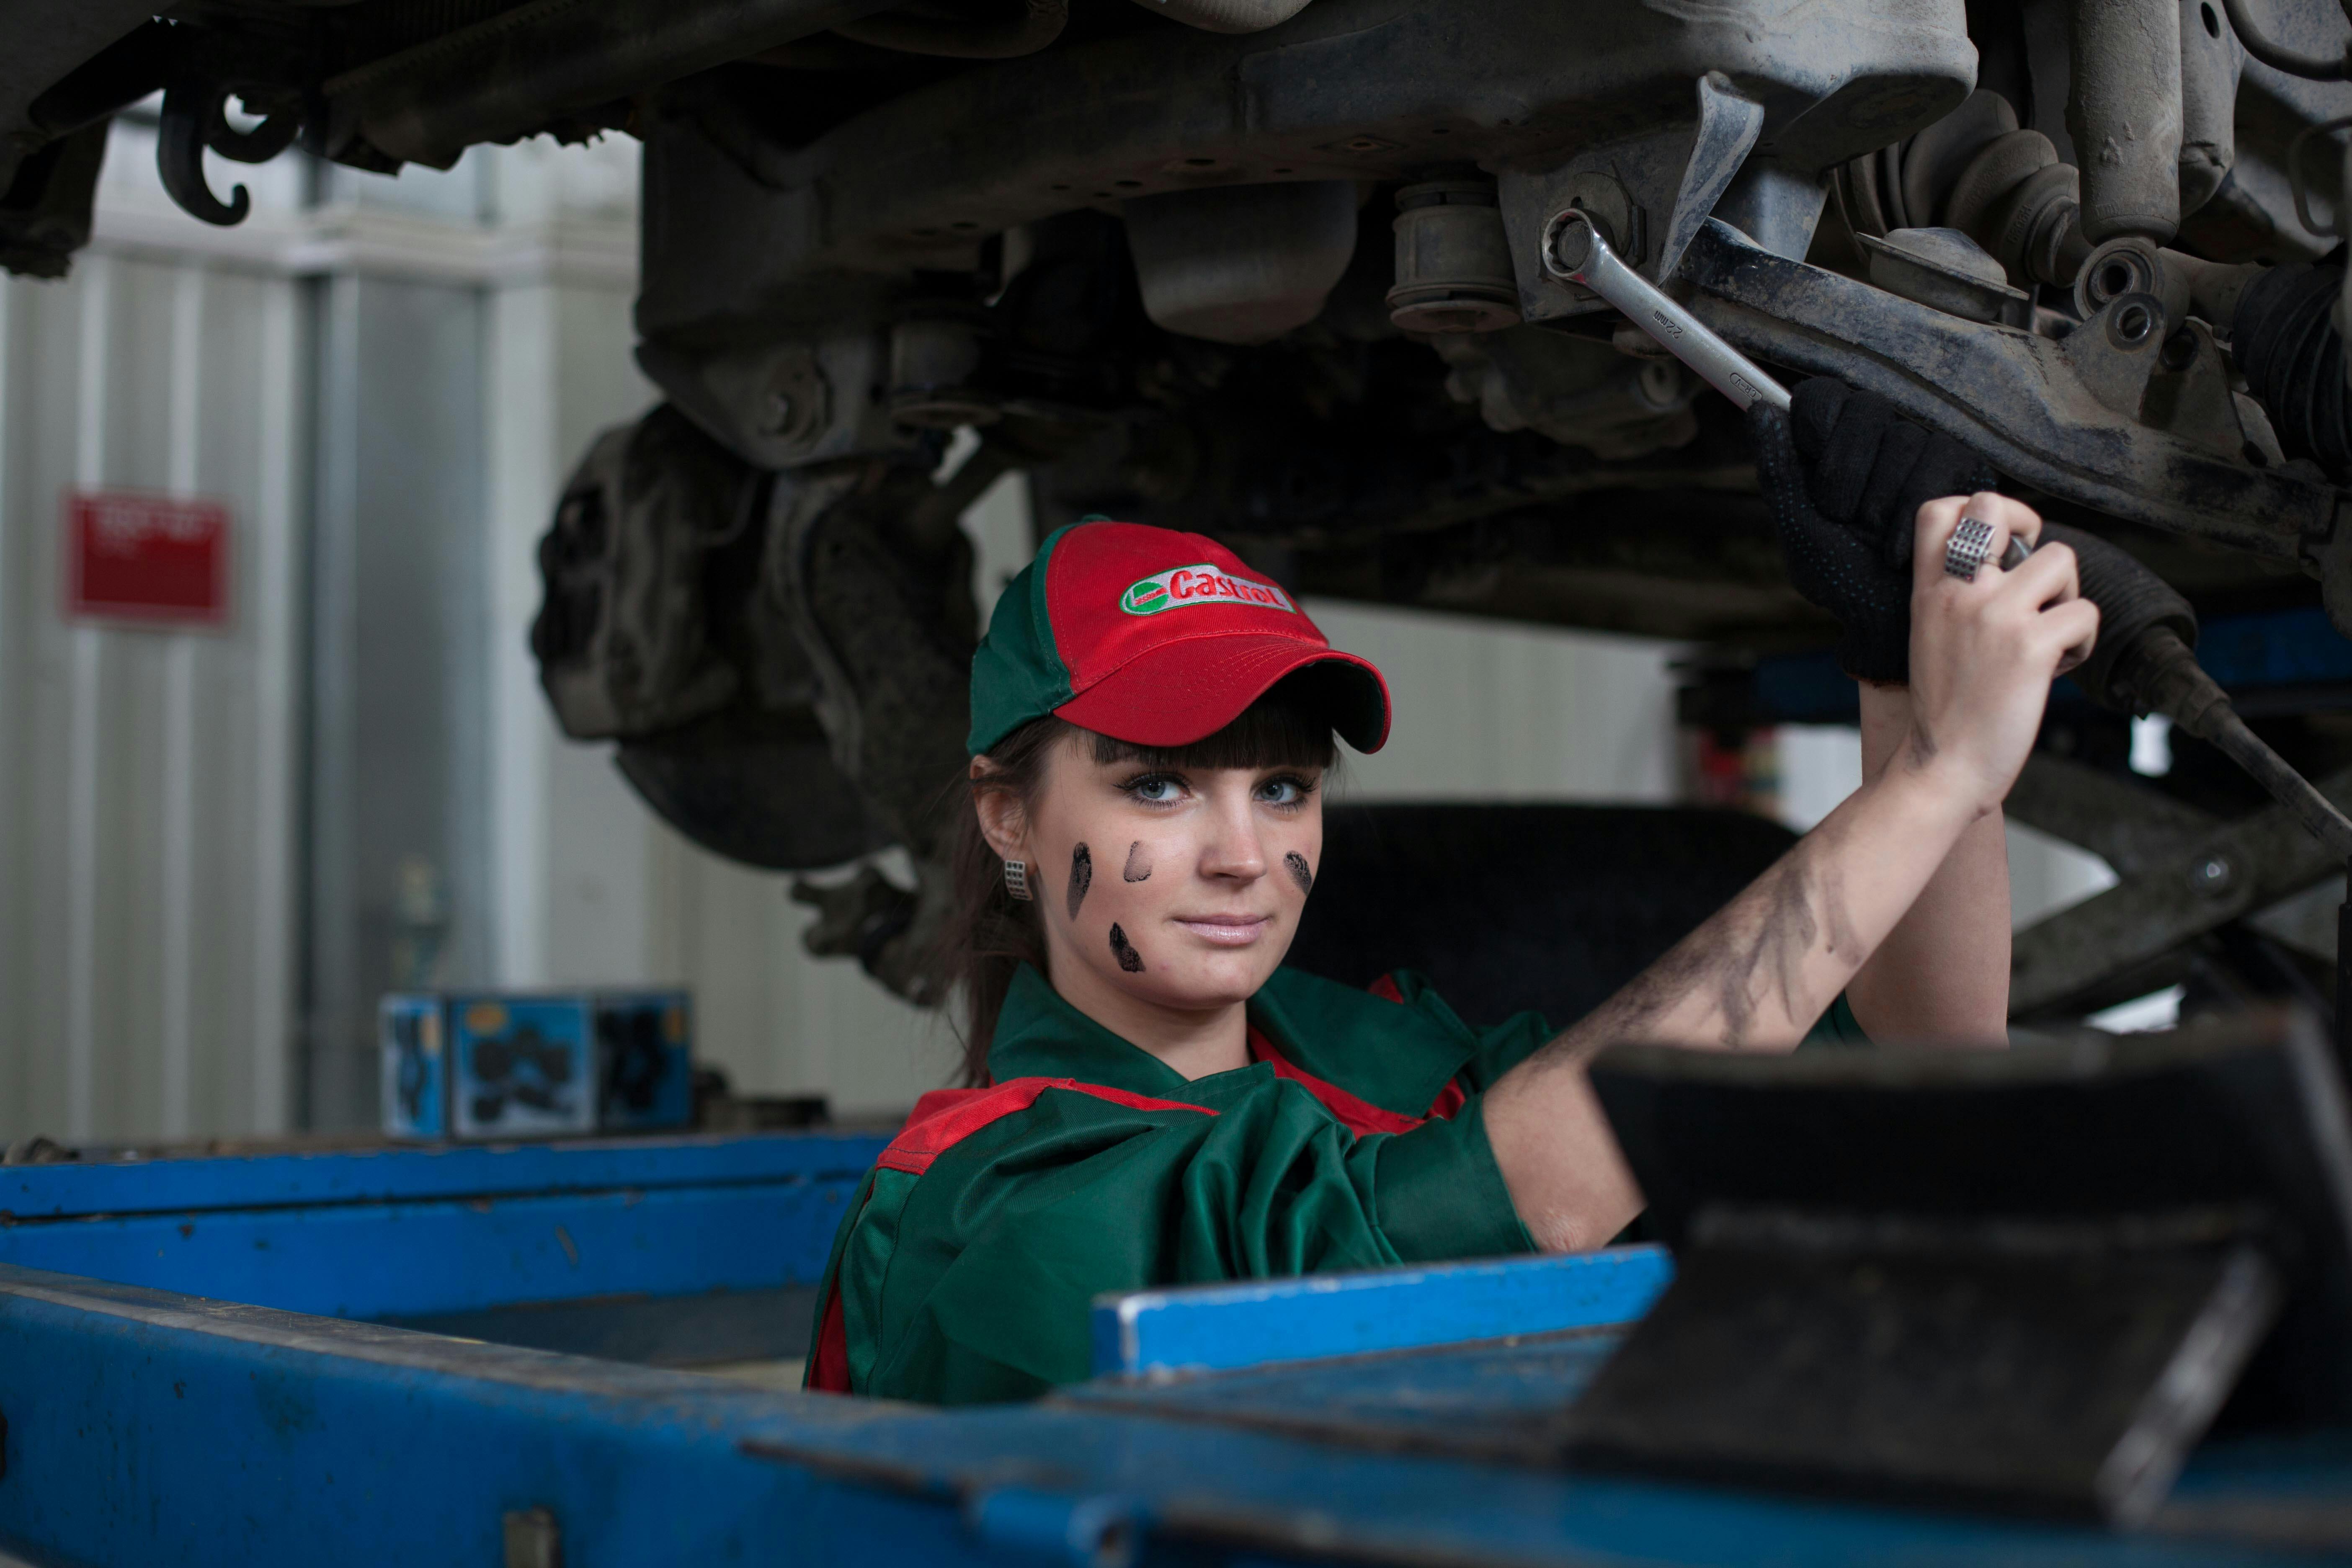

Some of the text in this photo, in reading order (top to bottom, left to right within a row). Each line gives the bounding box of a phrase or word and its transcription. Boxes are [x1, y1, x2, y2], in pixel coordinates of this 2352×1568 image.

[1653, 310, 1682, 339] 22mm
[1735, 378, 1756, 397] CR-V
[1170, 570, 1285, 607] Castrol
